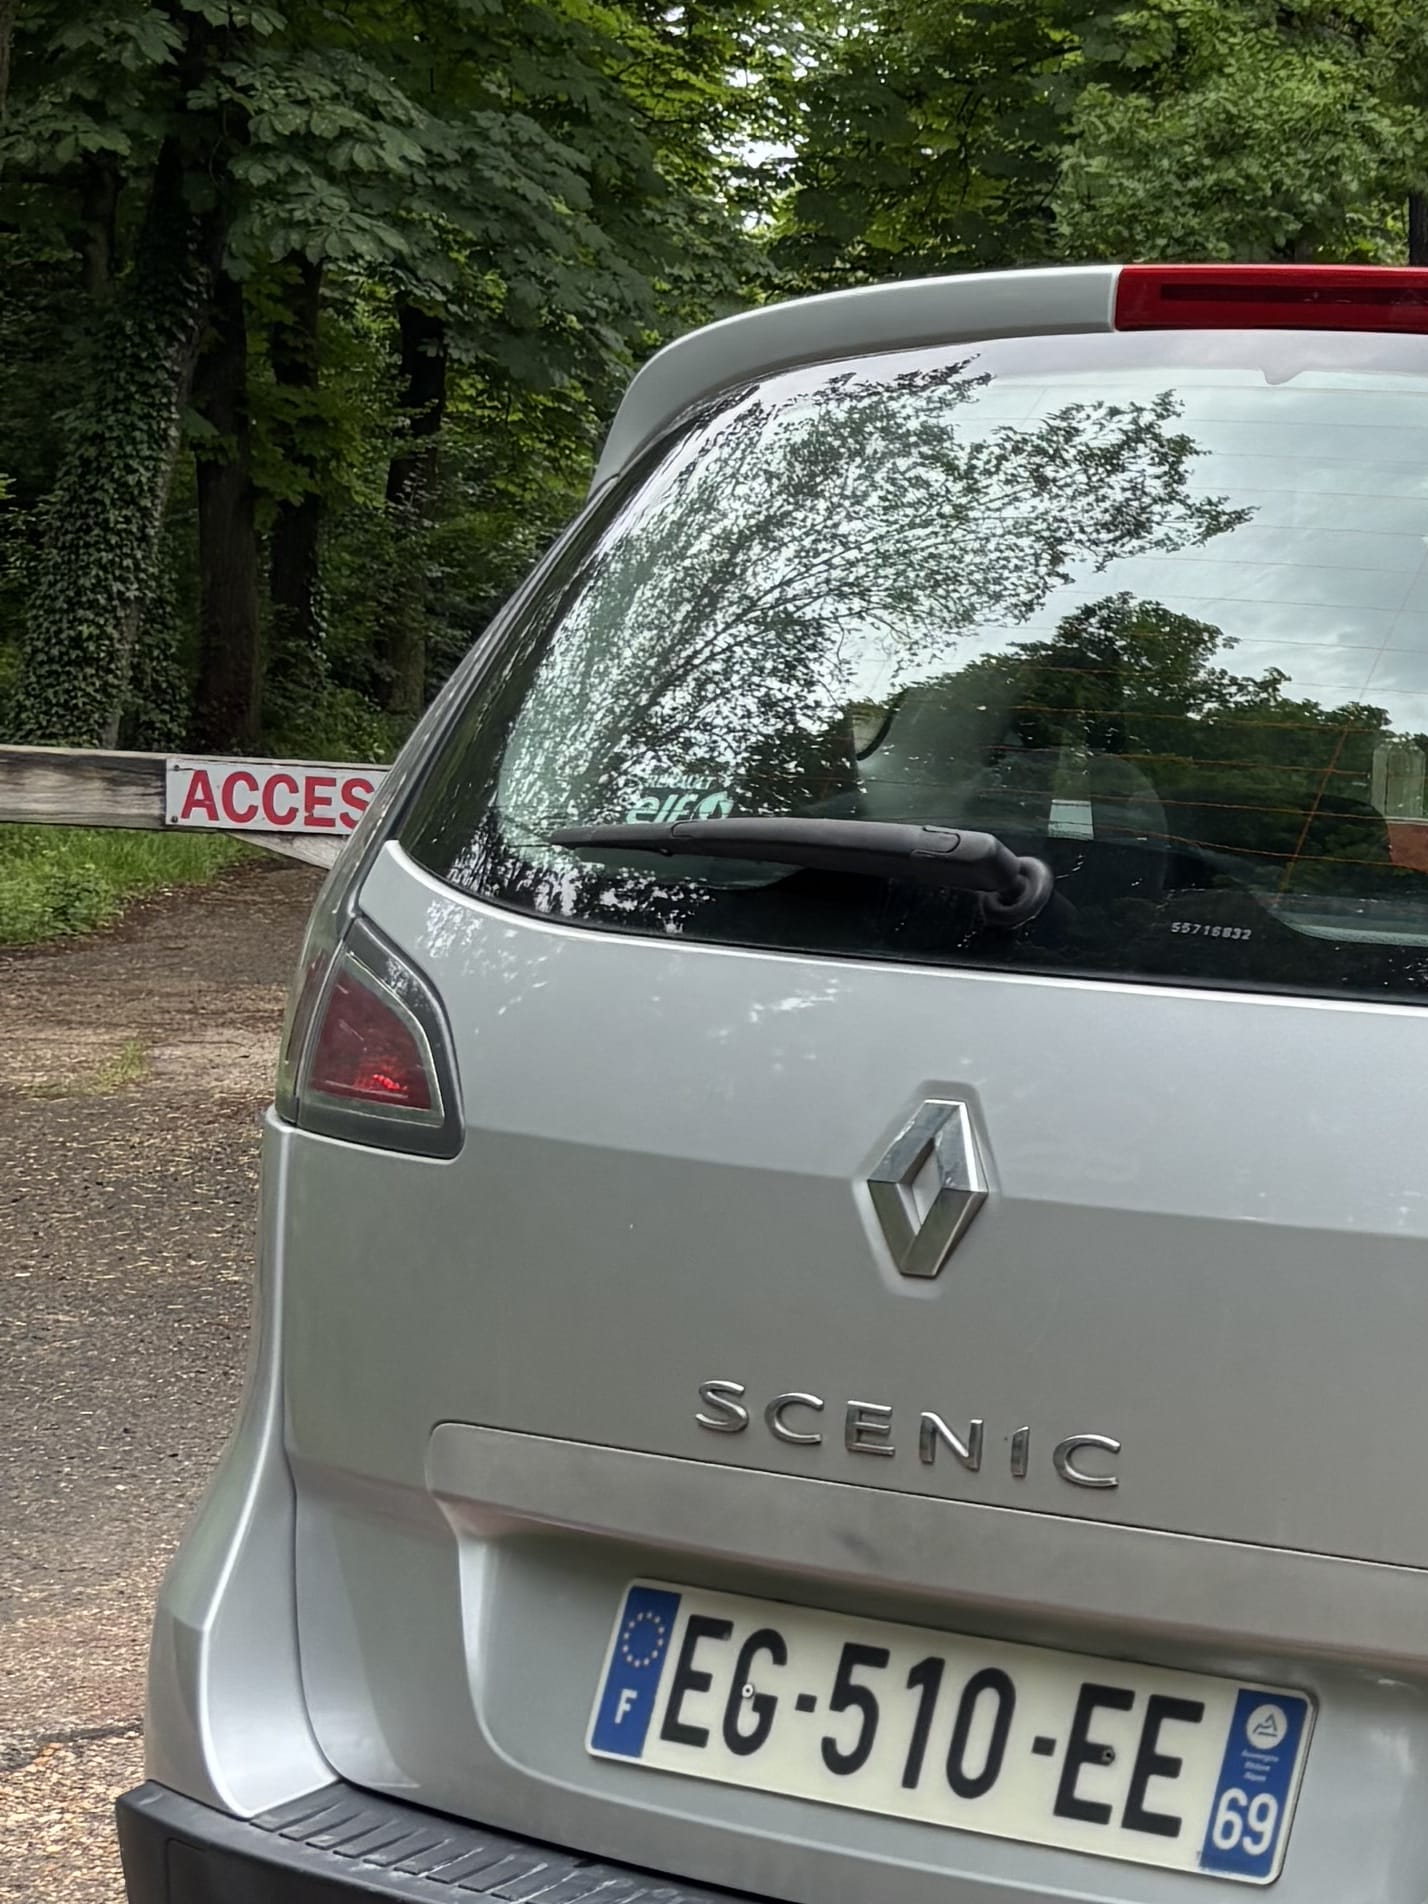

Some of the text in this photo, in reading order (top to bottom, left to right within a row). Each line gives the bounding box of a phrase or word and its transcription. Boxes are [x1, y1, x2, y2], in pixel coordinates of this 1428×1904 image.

[695, 1379, 1122, 1489] SCENIC
[614, 1687, 638, 1725] F
[659, 1613, 1206, 1838] EG-510-EE
[1210, 1787, 1279, 1856] 69
